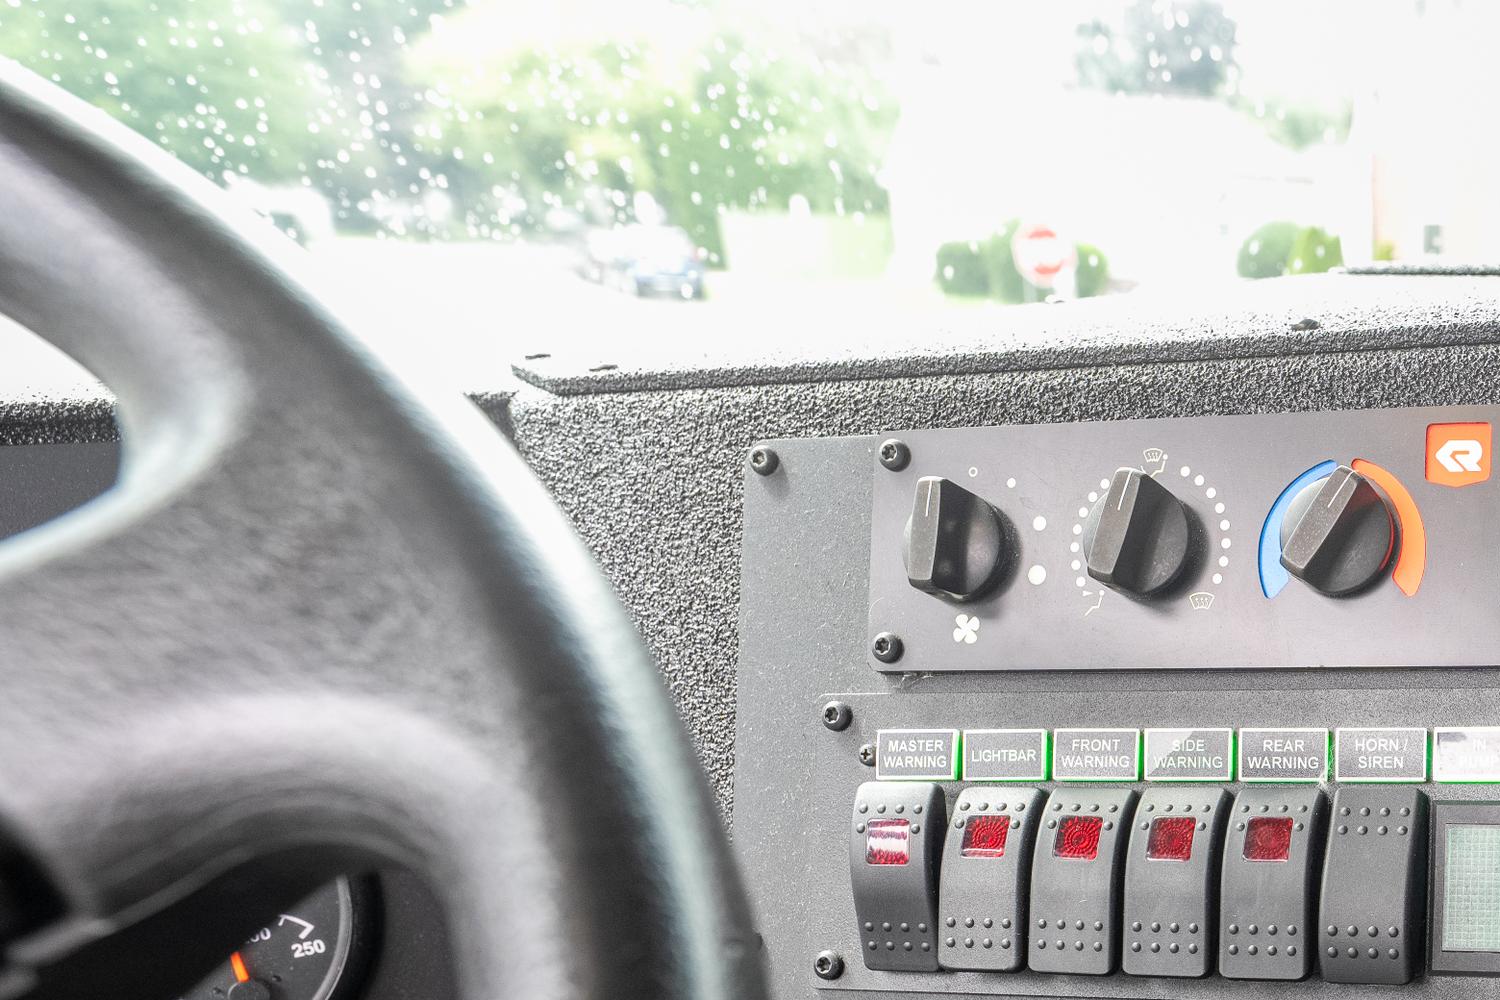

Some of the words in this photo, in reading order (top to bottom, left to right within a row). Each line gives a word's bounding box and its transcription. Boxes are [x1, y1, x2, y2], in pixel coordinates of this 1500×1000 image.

[887, 739, 944, 753] MASTER
[1072, 739, 1121, 752] FRONT
[1171, 739, 1206, 753] SIDE
[1262, 739, 1305, 753] REAR
[1355, 738, 1396, 752] HORN
[883, 755, 947, 769] WARNING
[971, 749, 1037, 763] LIGHTBAR
[1061, 755, 1130, 769] WARNING
[1153, 755, 1223, 769] WARNING
[1247, 756, 1319, 769] WARNING
[1358, 756, 1404, 769] SIREN
[291, 939, 326, 958] 250
